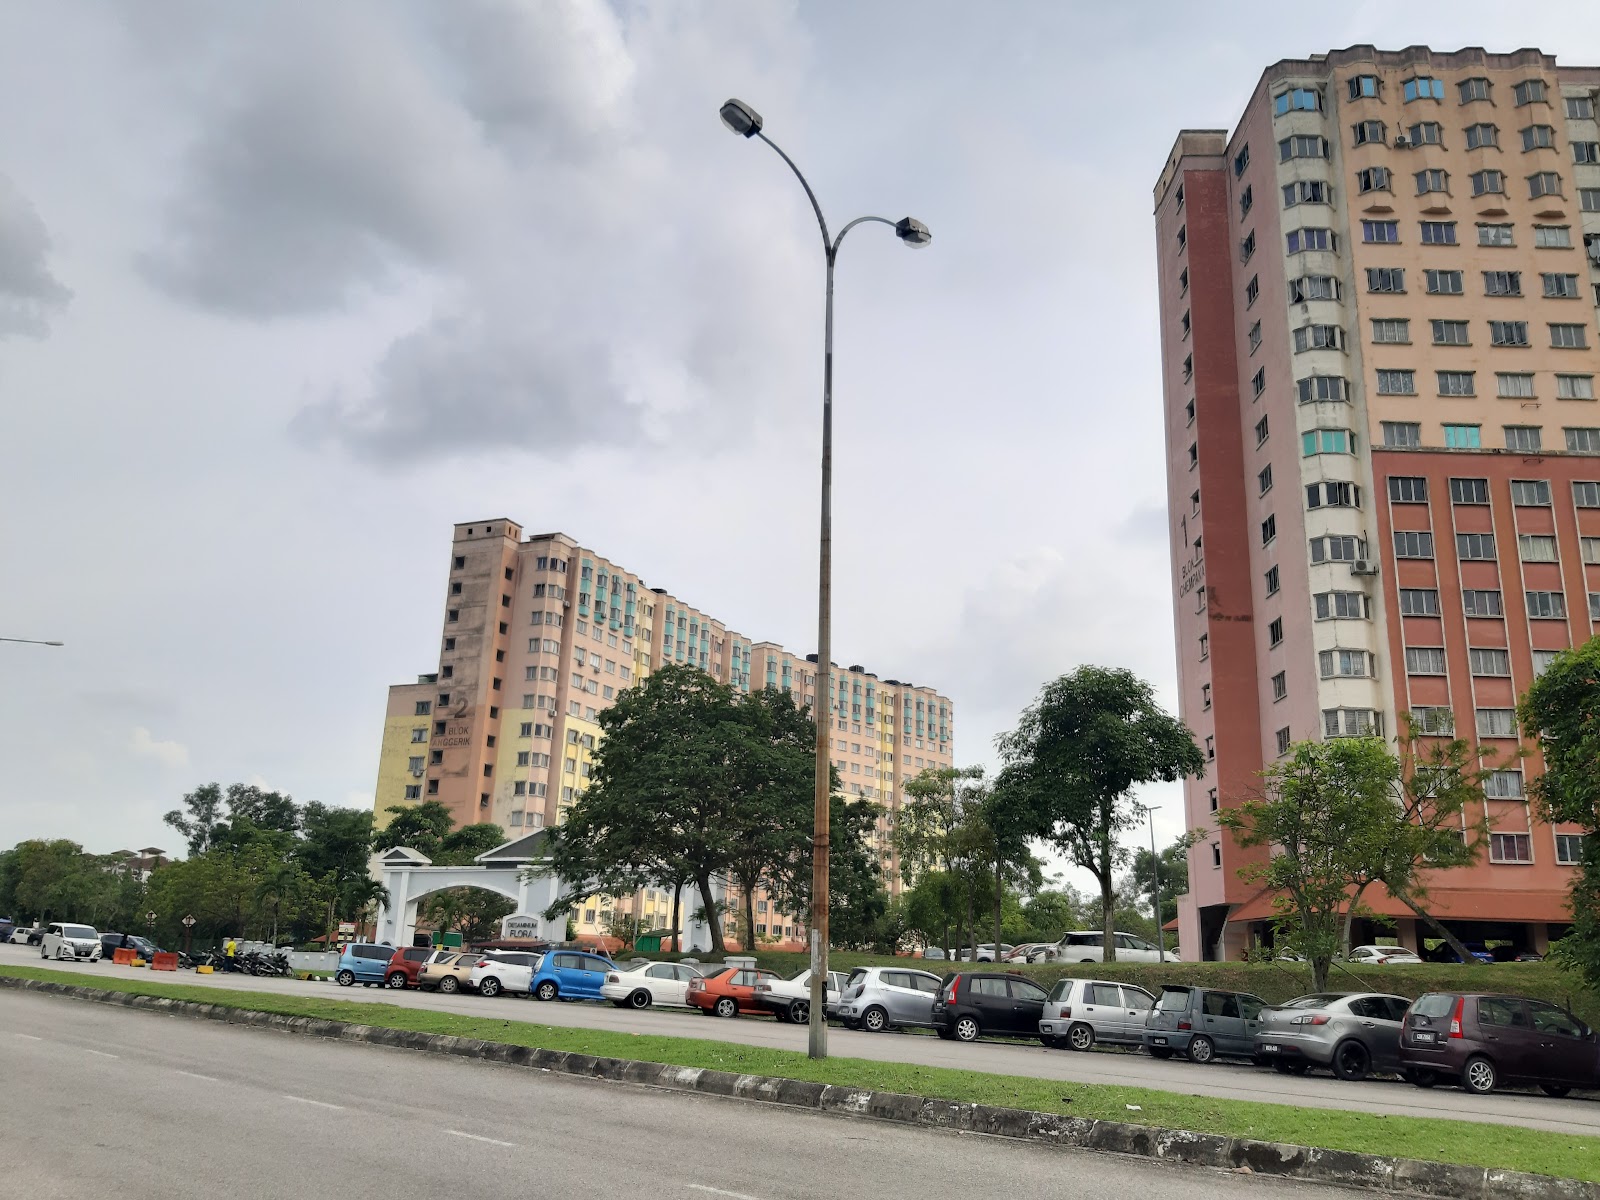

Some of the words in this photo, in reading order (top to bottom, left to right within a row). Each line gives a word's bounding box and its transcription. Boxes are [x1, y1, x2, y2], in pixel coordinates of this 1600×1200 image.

[453, 697, 469, 719] 2
[448, 726, 469, 736] BLOK
[432, 737, 471, 747] ANGGERIK
[509, 929, 533, 938] FLORA
